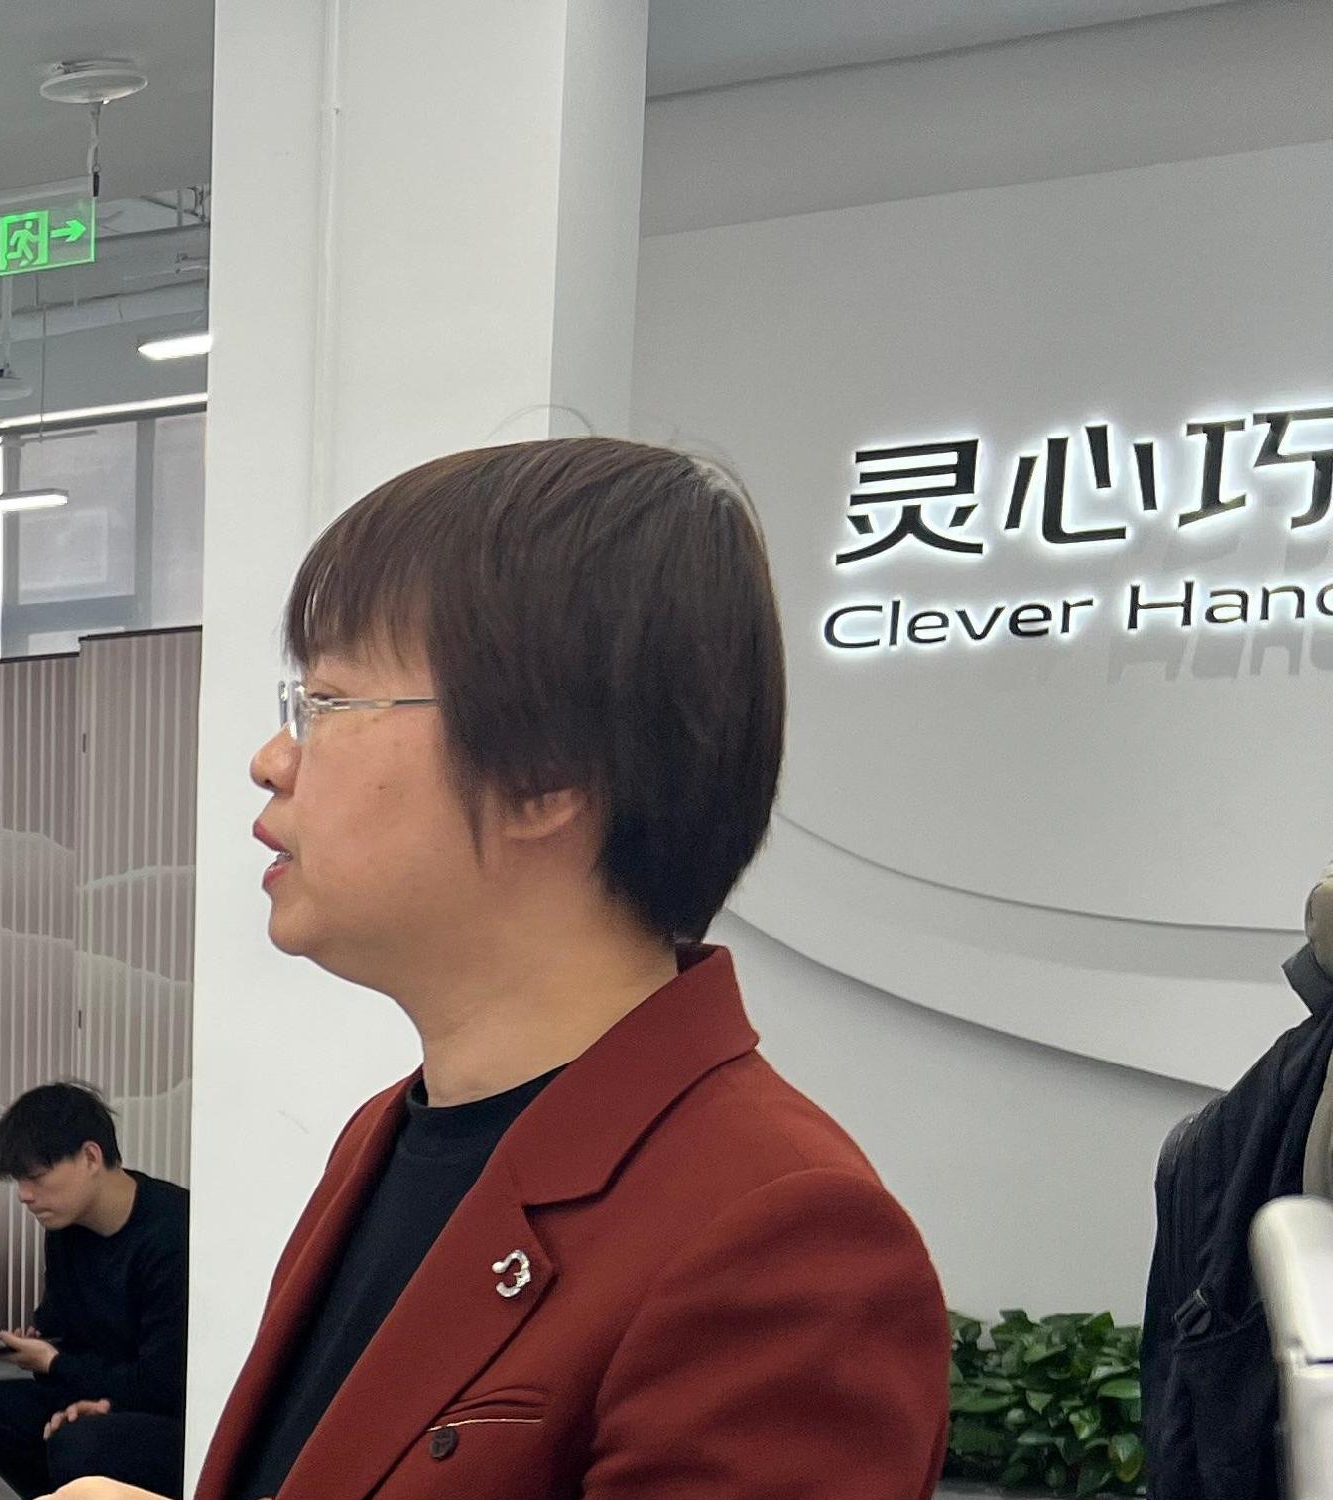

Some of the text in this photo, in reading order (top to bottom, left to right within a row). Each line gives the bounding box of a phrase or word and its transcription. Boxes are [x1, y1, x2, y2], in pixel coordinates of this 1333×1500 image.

[834, 406, 1333, 566] 灵心巧
[823, 597, 1095, 650] Clever
